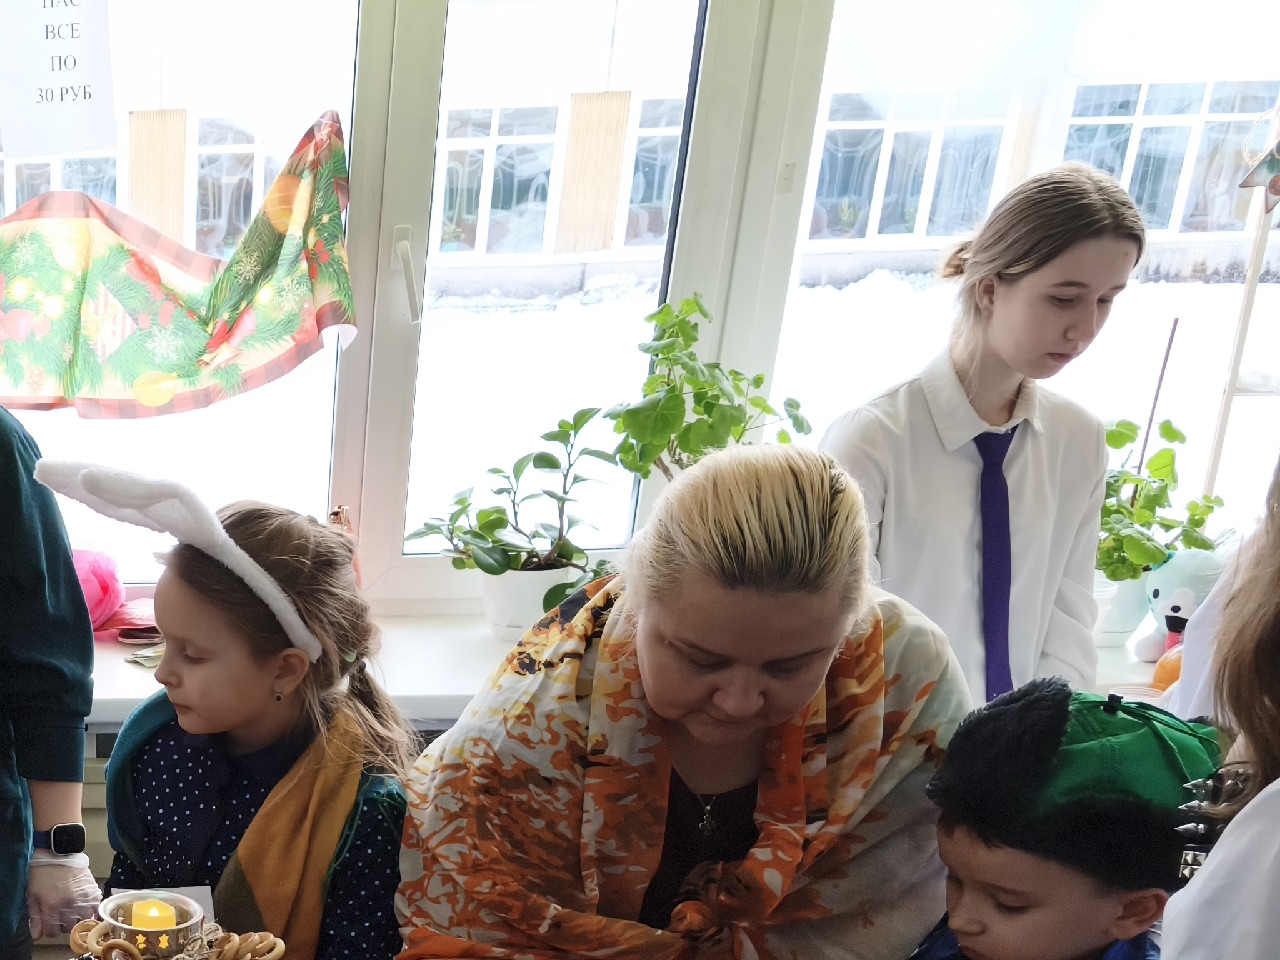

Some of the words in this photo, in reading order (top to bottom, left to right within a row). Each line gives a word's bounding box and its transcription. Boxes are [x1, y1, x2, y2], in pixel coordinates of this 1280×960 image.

[45, 22, 81, 40] ВСЕ
[51, 54, 77, 71] ПО
[35, 87, 55, 104] 30
[60, 84, 92, 102] РУБ
